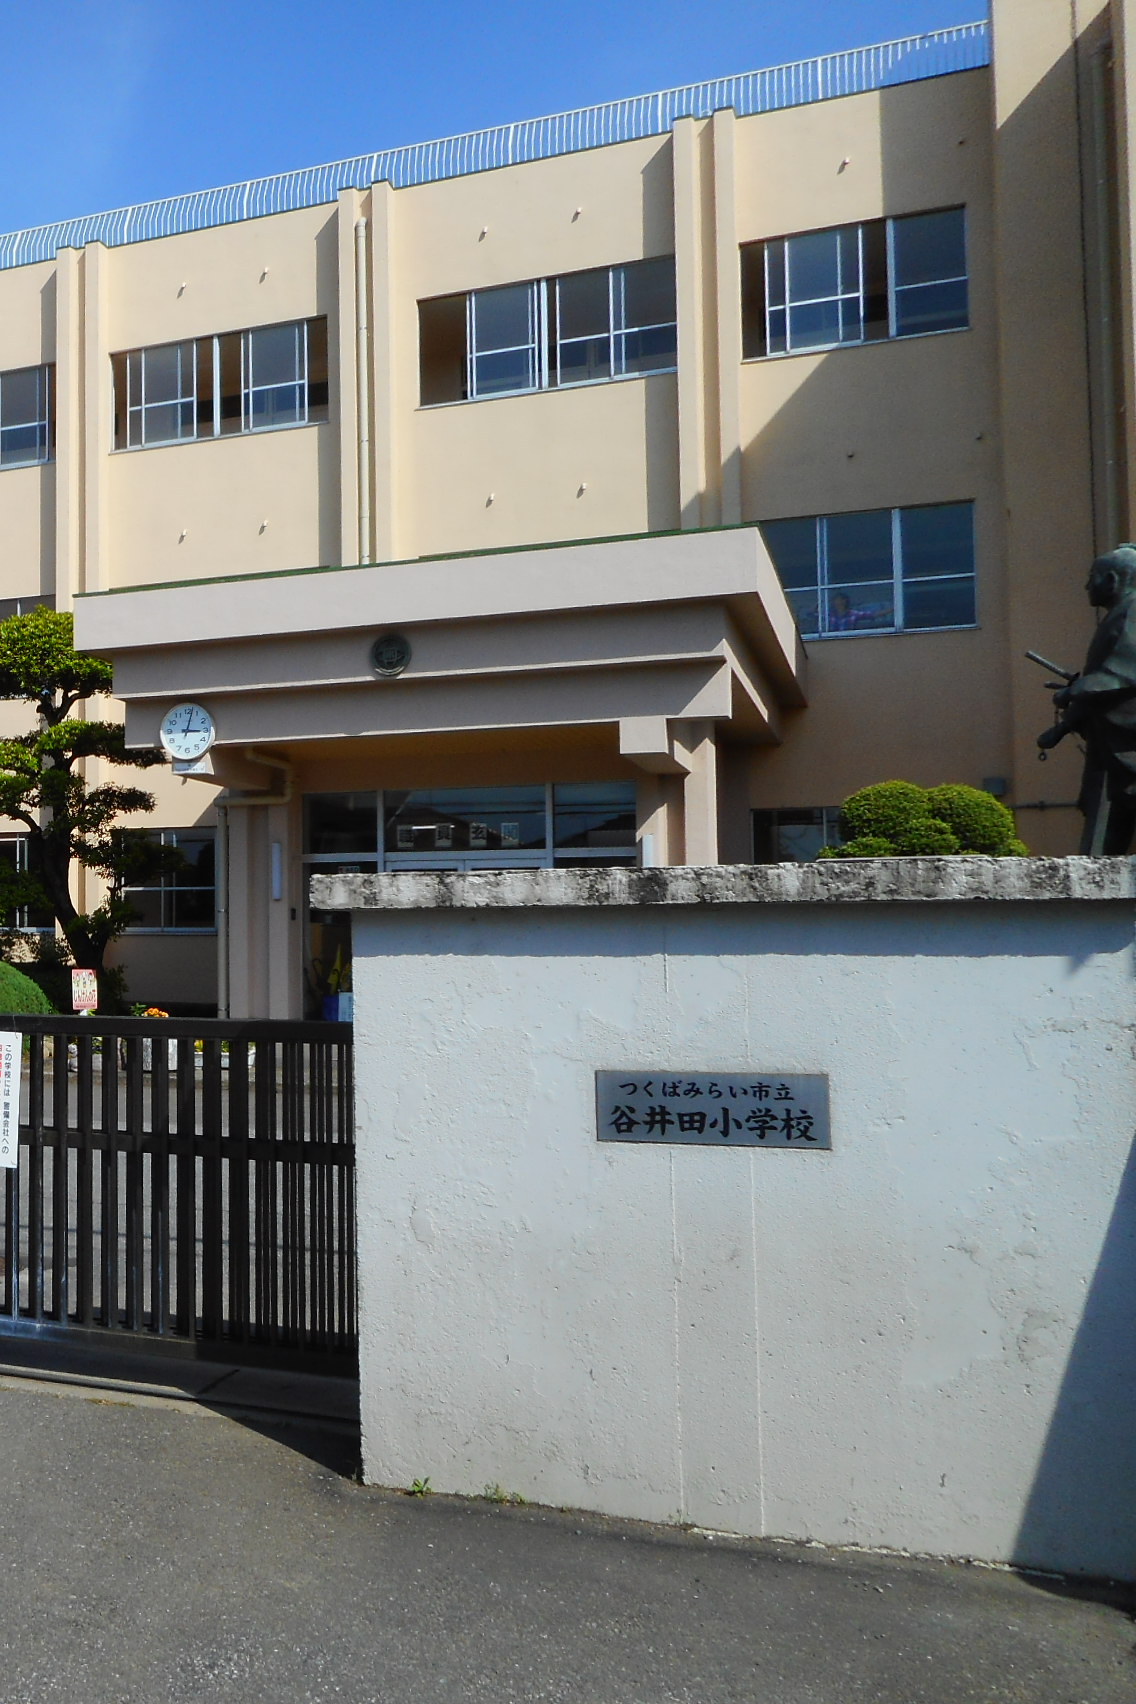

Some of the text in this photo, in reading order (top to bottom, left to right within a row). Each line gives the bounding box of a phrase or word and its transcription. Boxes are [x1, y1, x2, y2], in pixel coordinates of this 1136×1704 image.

[3, 1043, 13, 1097] この学校には
[618, 1080, 795, 1101] つくばみらい市立
[609, 1104, 818, 1142] 谷井田小学校
